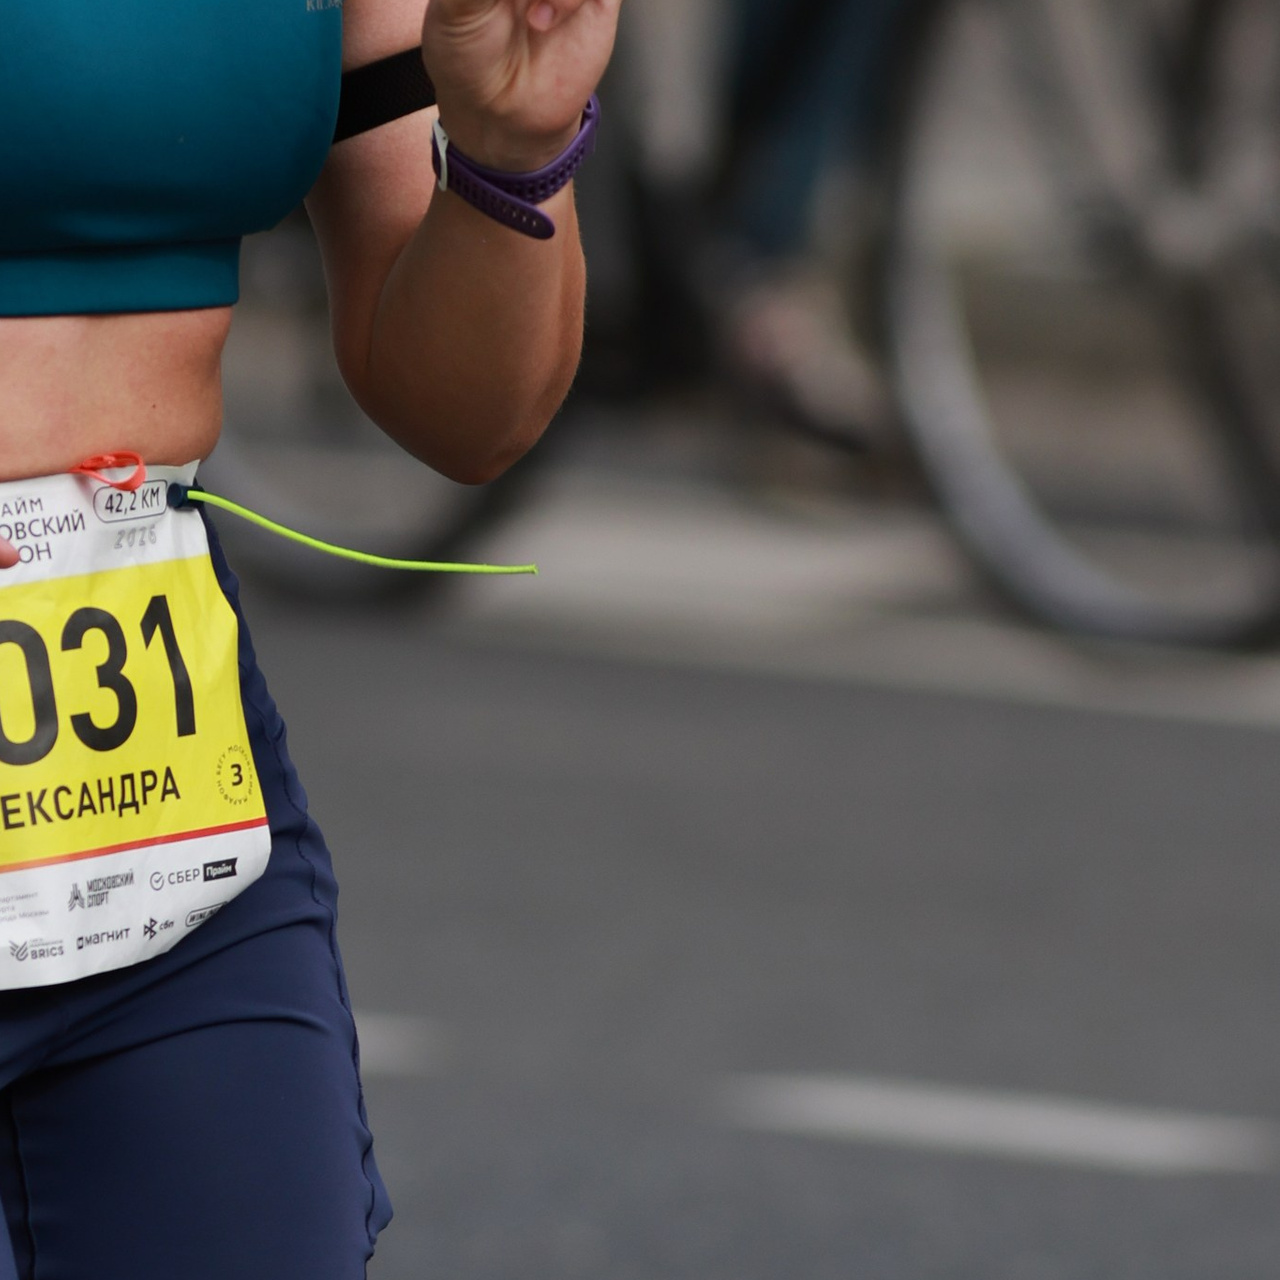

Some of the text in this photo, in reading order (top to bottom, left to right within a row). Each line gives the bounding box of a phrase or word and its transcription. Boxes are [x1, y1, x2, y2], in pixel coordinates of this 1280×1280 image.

[105, 487, 160, 515] 42,2 КМ
[230, 763, 243, 786] 3
[86, 867, 135, 893] МОСКОВСКИЙ
[167, 862, 233, 886] СБЕР Прайм
[87, 891, 110, 908] СПОРТ
[30, 945, 64, 960] BRICS
